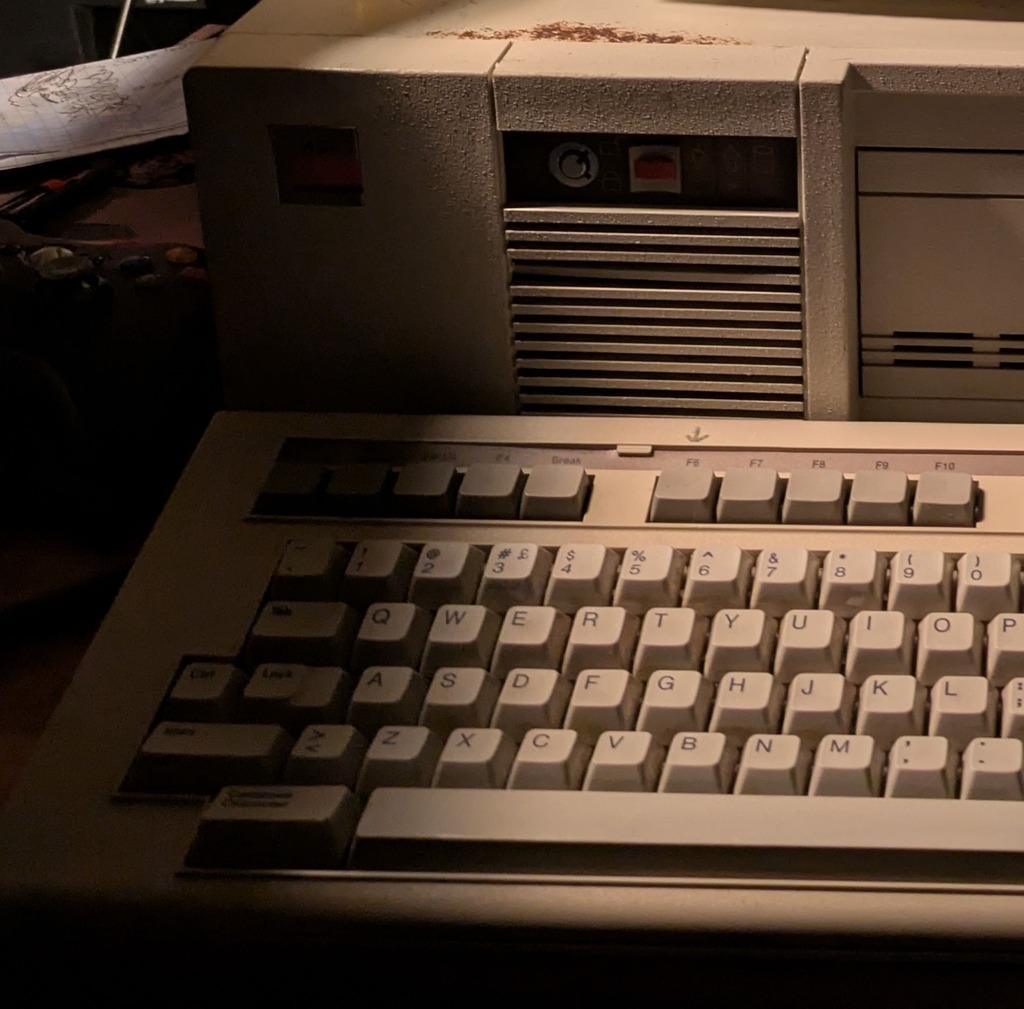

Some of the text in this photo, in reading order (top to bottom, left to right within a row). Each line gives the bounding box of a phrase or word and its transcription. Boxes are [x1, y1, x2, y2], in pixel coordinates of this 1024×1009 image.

[552, 456, 582, 465] Break
[750, 459, 764, 467] F7
[812, 460, 825, 468] F8
[876, 461, 889, 470] F9
[935, 462, 955, 470] F10
[372, 609, 390, 625] Q
[446, 610, 466, 625] W
[511, 611, 527, 626] E
[582, 612, 598, 626] R
[655, 613, 668, 627] T
[725, 614, 739, 628] Y
[792, 615, 807, 629] U
[1003, 618, 1016, 632] P
[367, 672, 382, 686] A
[440, 673, 456, 688] S
[512, 674, 529, 688] D
[584, 675, 600, 689] F
[658, 676, 674, 690] G
[729, 678, 745, 692] H
[801, 680, 813, 695] J
[873, 680, 887, 695] K
[945, 681, 957, 696] L
[382, 731, 400, 745] Z
[457, 733, 475, 747] X
[533, 734, 550, 748] C
[609, 736, 624, 749] V
[681, 737, 697, 750] B
[756, 739, 772, 752] N
[830, 740, 849, 753] M
